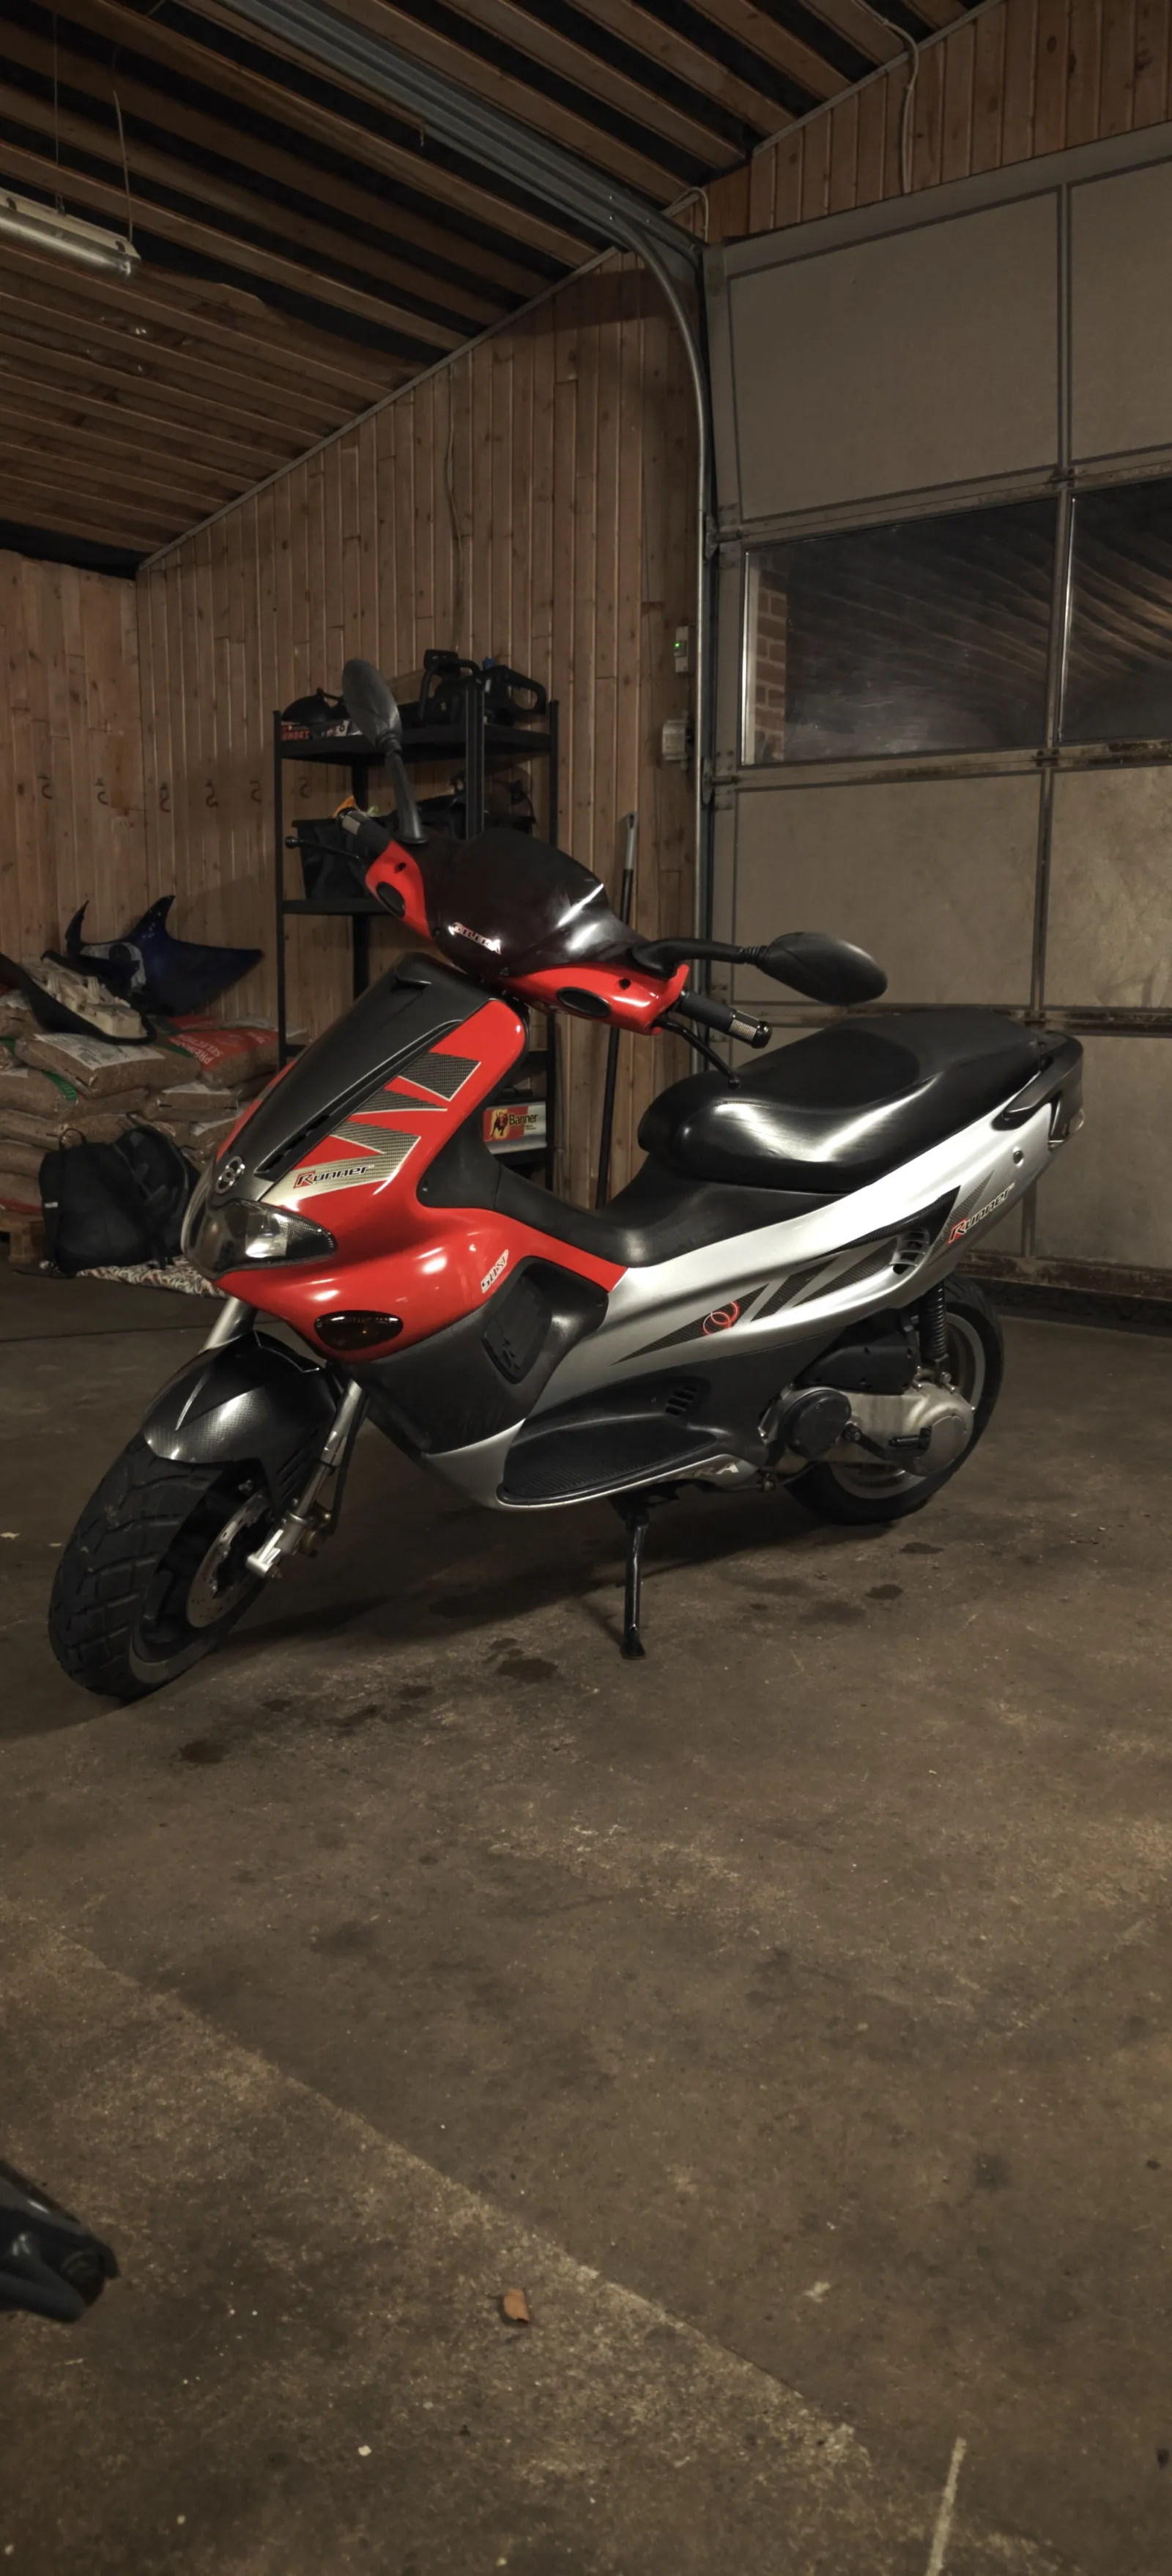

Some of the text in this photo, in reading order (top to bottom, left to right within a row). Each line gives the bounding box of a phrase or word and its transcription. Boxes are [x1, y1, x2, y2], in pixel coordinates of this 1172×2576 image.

[509, 1114, 538, 1125] Banner
[293, 1164, 374, 1188] Runner
[946, 1181, 1015, 1245] Runner
